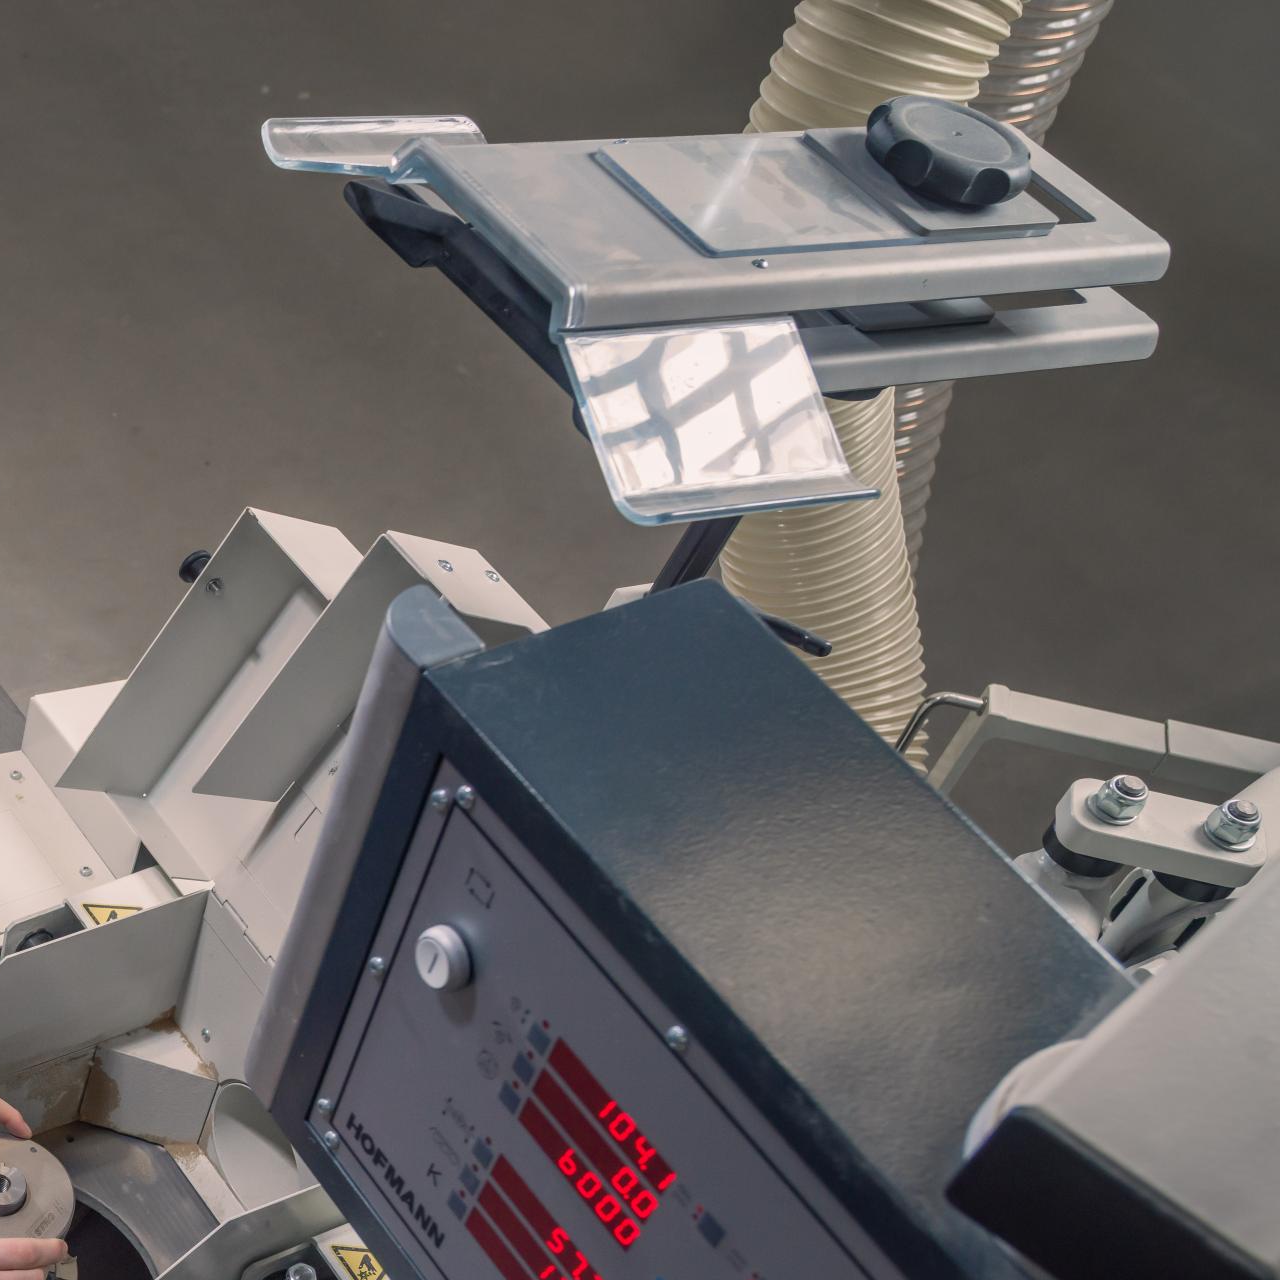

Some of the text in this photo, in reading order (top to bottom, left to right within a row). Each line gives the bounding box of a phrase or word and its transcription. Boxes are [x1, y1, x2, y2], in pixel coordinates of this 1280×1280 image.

[346, 1111, 445, 1249] HOFMANN
[599, 1100, 676, 1191] 104.1
[611, 1166, 659, 1219] 0.0
[558, 1147, 641, 1246] 6000
